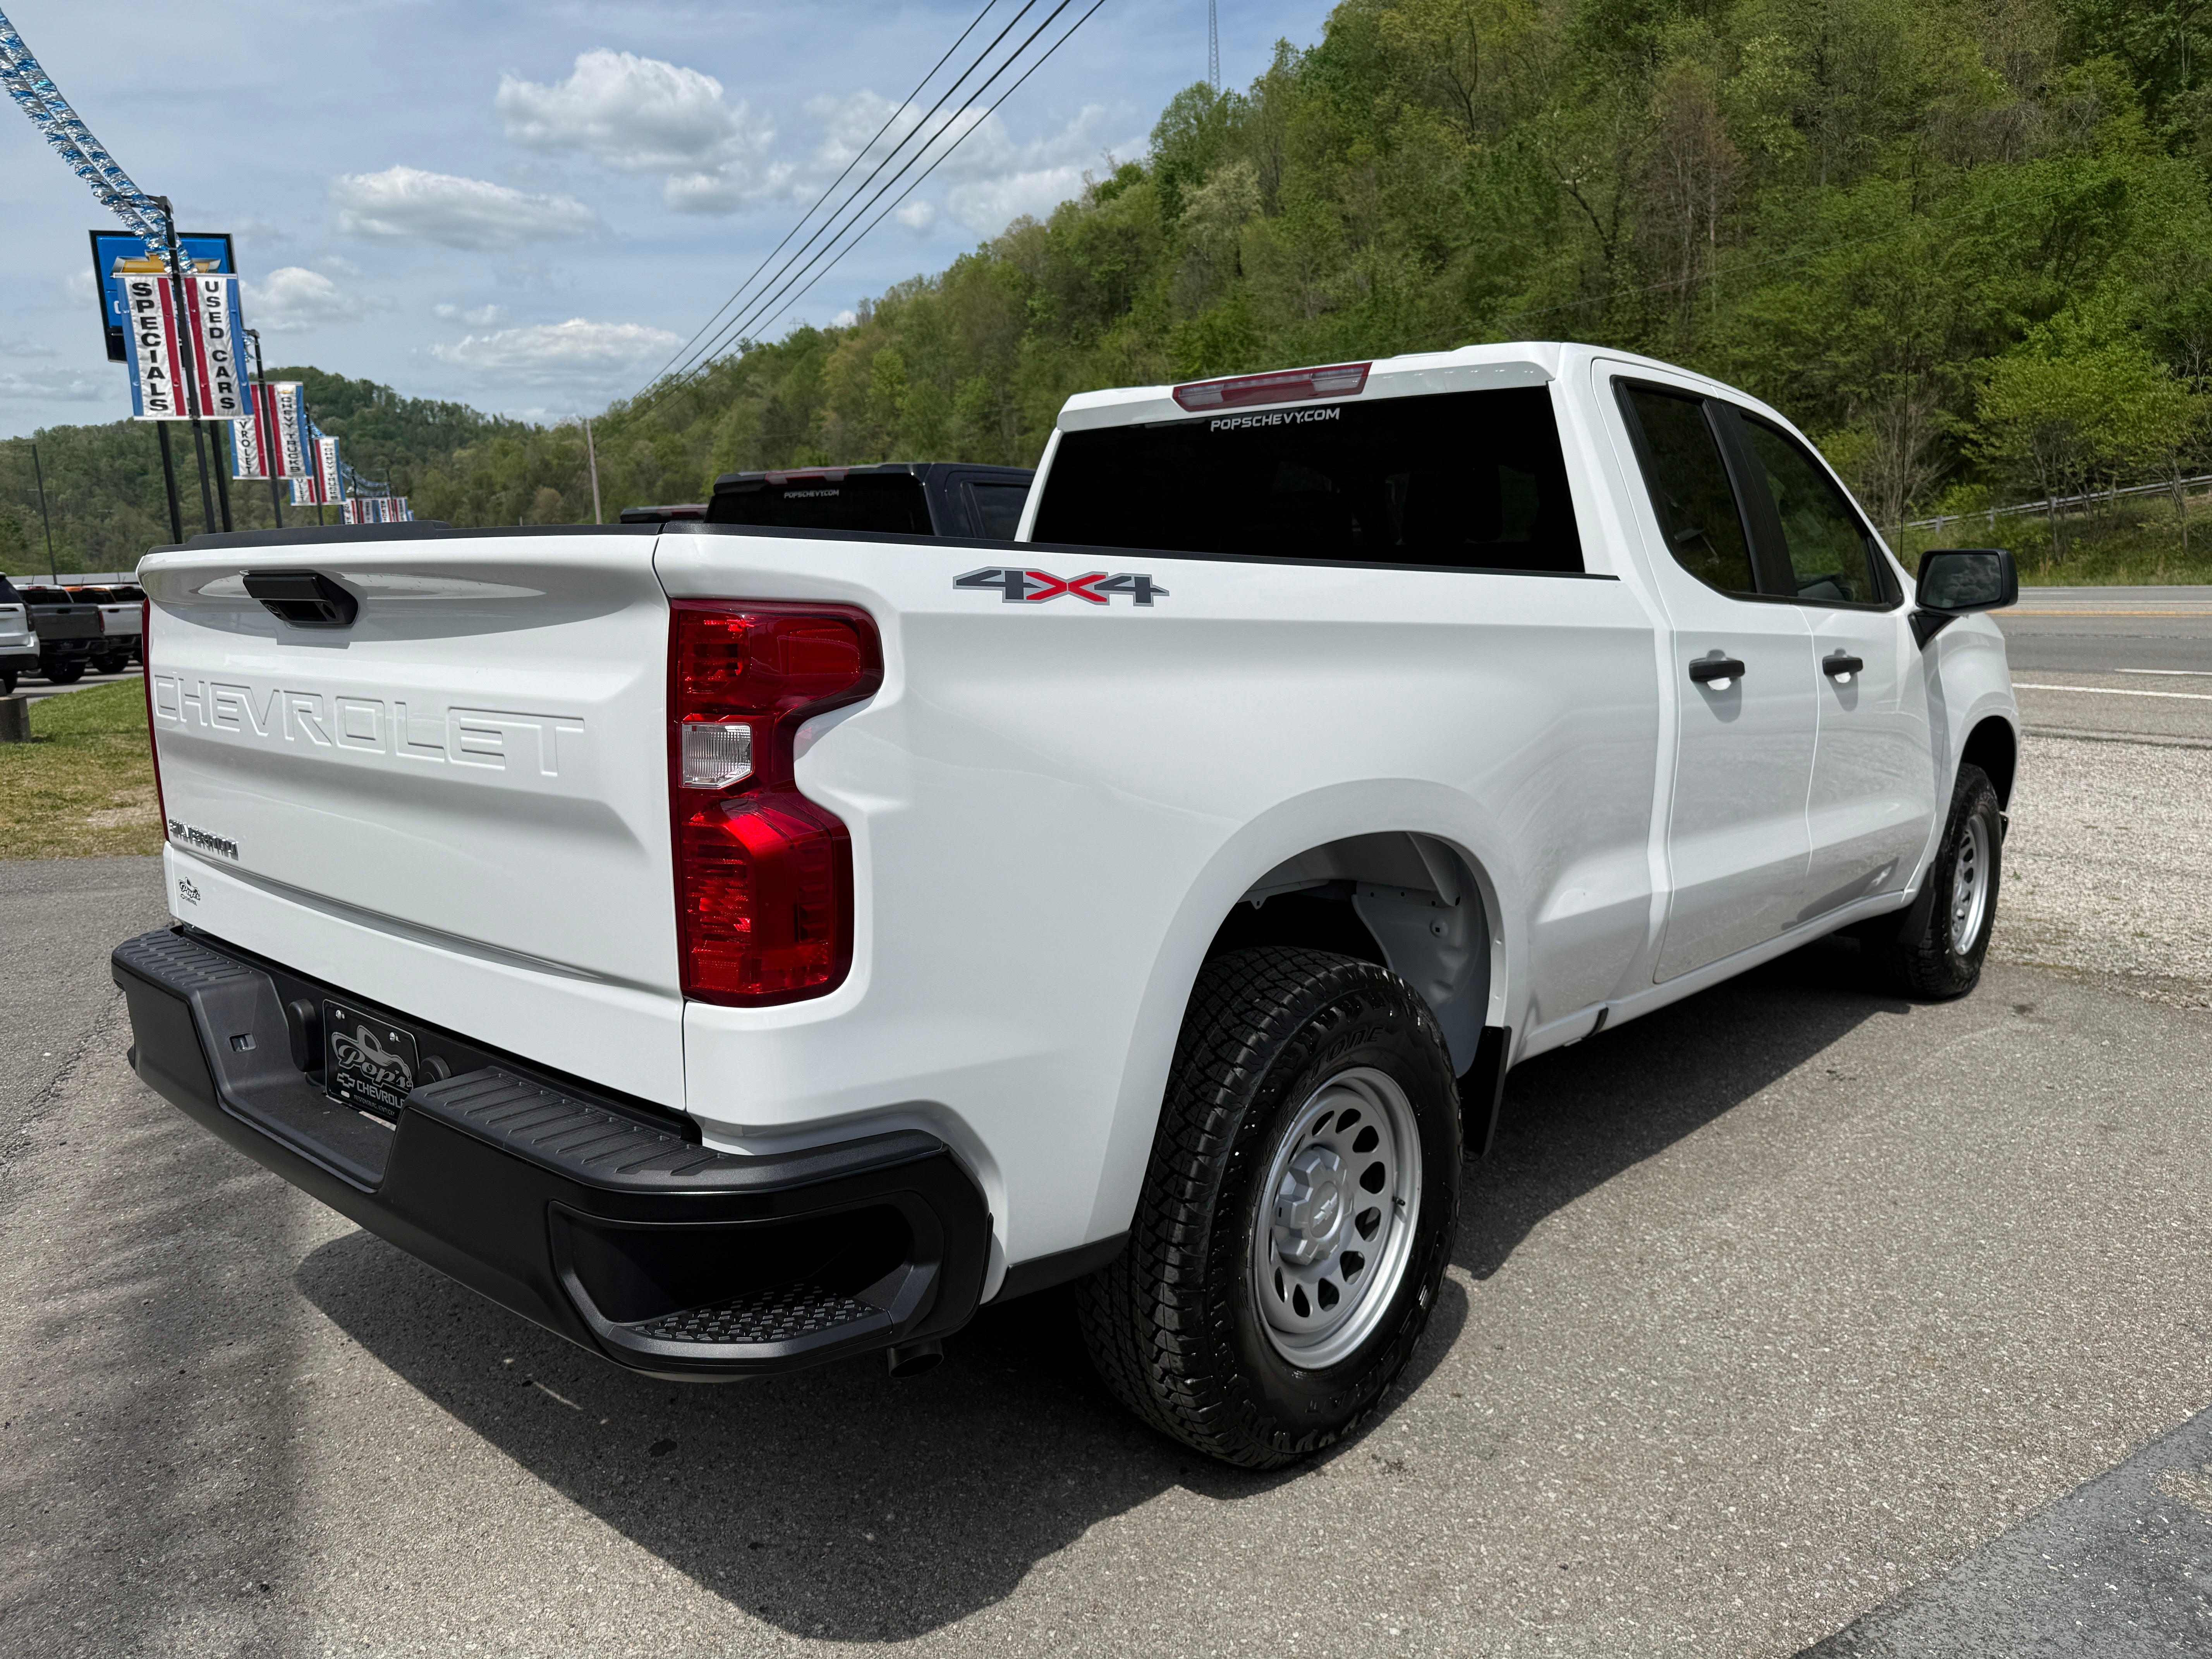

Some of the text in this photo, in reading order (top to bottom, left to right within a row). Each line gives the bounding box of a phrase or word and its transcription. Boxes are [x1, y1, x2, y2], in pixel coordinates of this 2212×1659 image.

[132, 282, 169, 411] SPECIALS
[205, 280, 236, 410] USED CARS
[281, 397, 293, 428] CHEVY
[1210, 407, 1340, 432] POPSCHEVY.COM
[239, 421, 251, 474] VROLET
[783, 489, 840, 499] POPSCHEVY.COM
[155, 675, 585, 776] CHEVROLET
[338, 1045, 408, 1088] Pop's
[356, 1080, 405, 1109] CHEVROL
